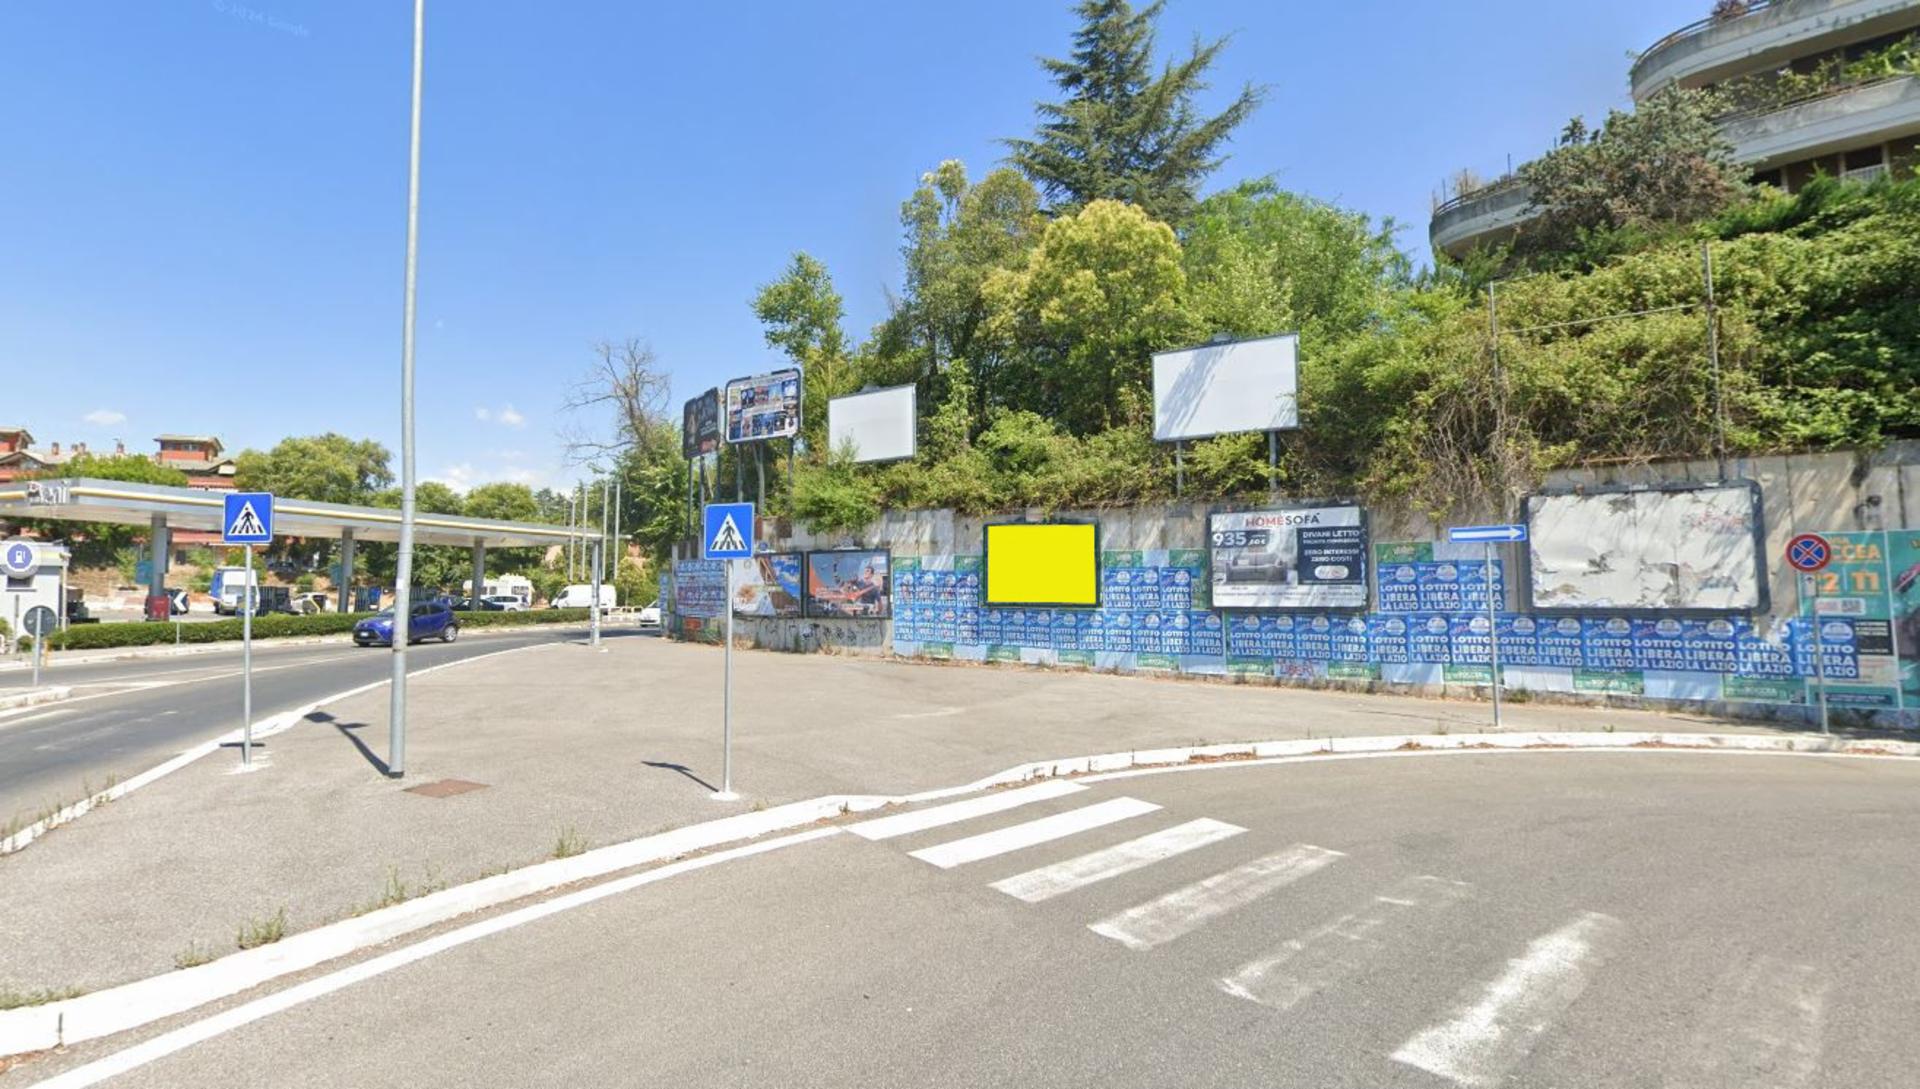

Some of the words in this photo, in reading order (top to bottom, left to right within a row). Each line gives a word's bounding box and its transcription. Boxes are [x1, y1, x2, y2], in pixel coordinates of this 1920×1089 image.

[1246, 514, 1320, 527] HOMESOFA
[1213, 532, 1247, 546] 935
[1461, 583, 1501, 591] LOTIO
[1420, 592, 1460, 601] LIBERA
[1394, 602, 1418, 610] LAZIO
[1420, 602, 1432, 610] LA
[1434, 602, 1460, 610] LAZIO
[1475, 602, 1503, 610] LAIO
[1370, 636, 1406, 644] LOTITO
[1539, 638, 1581, 646] LOTITO
[1586, 639, 1632, 647] LOTITO
[1635, 639, 1682, 648] LOTITO
[1262, 641, 1294, 650] LIBERA
[1297, 642, 1329, 651] LIBERA
[1332, 644, 1366, 652] LIBERA
[1370, 645, 1407, 653] LIBERA
[1411, 644, 1449, 653] LIBERA
[1684, 640, 1735, 650] LOTITO
[1739, 642, 1790, 650] LOTIO
[1538, 647, 1582, 657] LIBERA
[1587, 648, 1632, 658] LIBERA
[1636, 649, 1683, 660] LIBERA
[1685, 650, 1736, 661] LIBERA
[1344, 653, 1368, 661] LAZIO
[1370, 654, 1380, 662] LA
[1383, 654, 1408, 662] LAZIO
[1411, 654, 1422, 662] LA
[1424, 654, 1450, 662] LAZIO
[1538, 657, 1551, 665] LA
[1554, 656, 1583, 666] LAZIO
[1587, 658, 1600, 666] LA
[1603, 658, 1634, 667] LAZIO
[1636, 660, 1649, 668] LA
[1652, 660, 1684, 669] LAZIO
[1686, 661, 1698, 669] LA
[1704, 662, 1737, 671] LAZIO
[1826, 666, 1857, 676] AZIO
